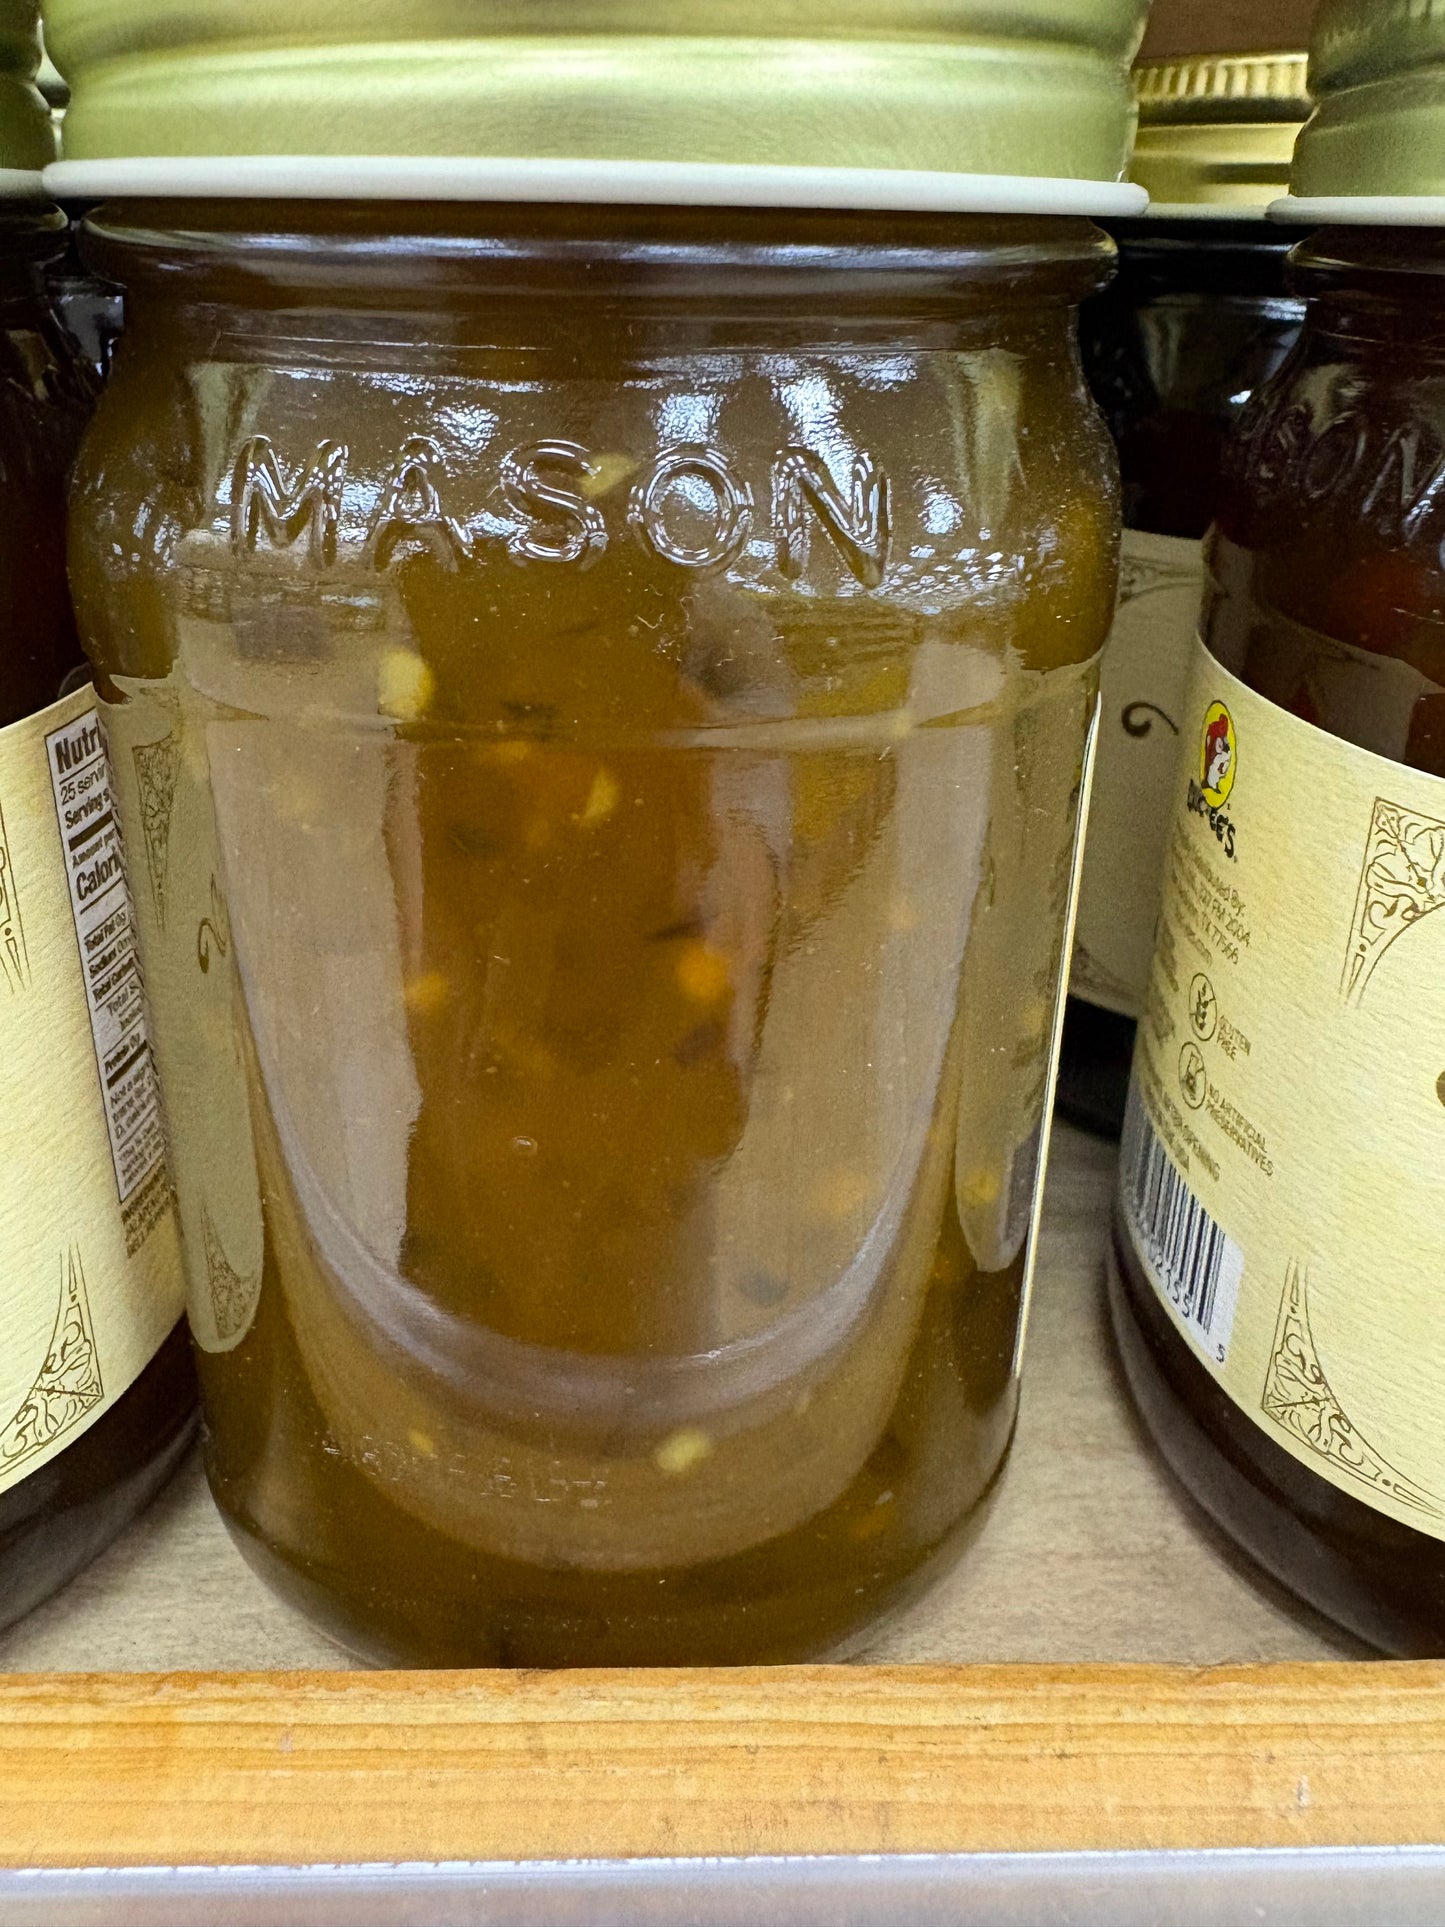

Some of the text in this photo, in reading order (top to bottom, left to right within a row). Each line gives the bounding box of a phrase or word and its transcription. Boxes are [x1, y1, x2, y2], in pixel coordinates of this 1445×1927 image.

[231, 434, 893, 589] MASON
[60, 782, 76, 806] 25
[65, 795, 103, 830] Serving
